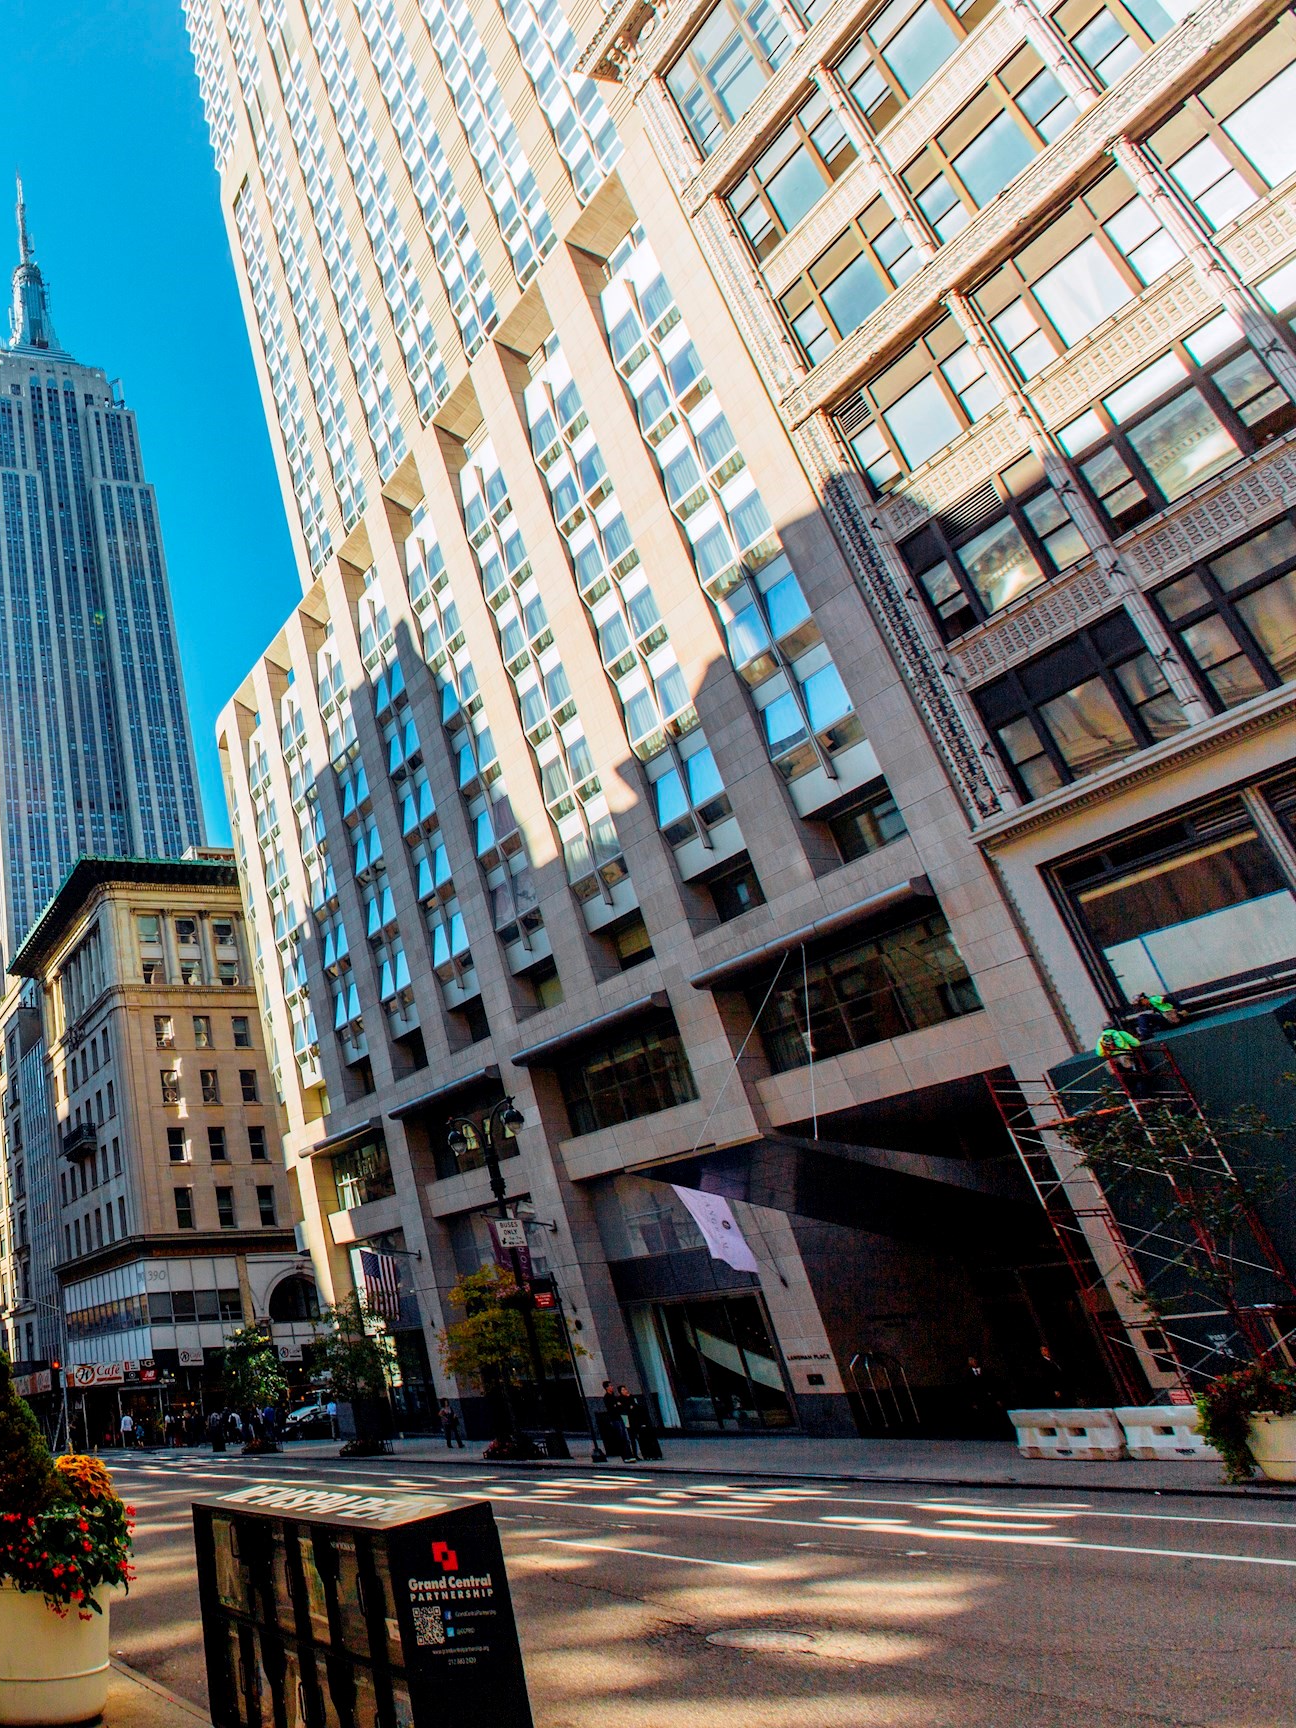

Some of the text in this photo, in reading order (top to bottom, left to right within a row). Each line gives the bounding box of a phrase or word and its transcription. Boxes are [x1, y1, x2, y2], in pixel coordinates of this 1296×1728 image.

[499, 1221, 518, 1229] BUSES
[147, 1270, 166, 1281] 390
[96, 1363, 120, 1377] Café
[216, 1485, 447, 1521] NEWSPAPERS
[408, 1573, 492, 1591] Grand Central
[409, 1588, 494, 1602] PARTNERSHIP
